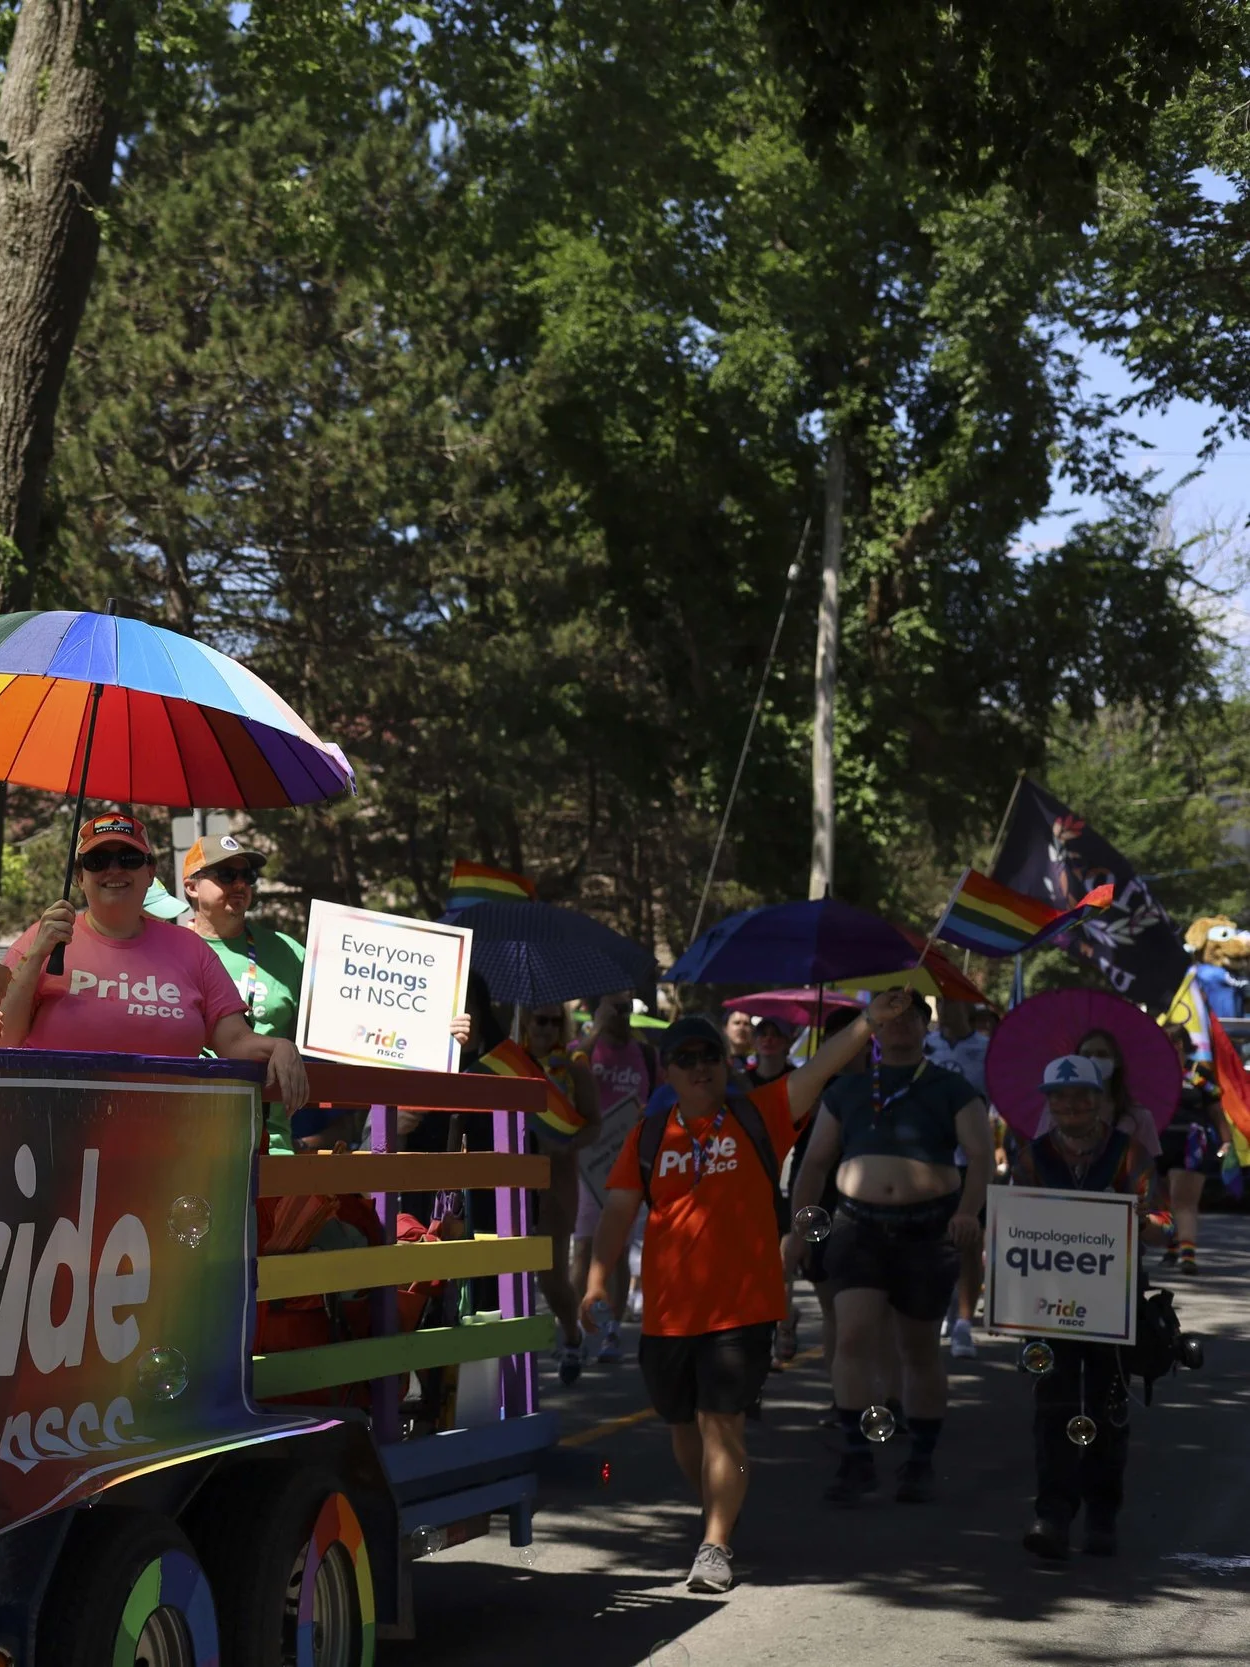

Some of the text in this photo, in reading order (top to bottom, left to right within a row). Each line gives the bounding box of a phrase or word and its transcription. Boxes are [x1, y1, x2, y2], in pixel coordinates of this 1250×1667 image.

[342, 934, 435, 967] Everyone
[344, 957, 427, 991] belongs
[69, 969, 181, 1003] Pride
[340, 985, 427, 1013] at NSCC
[127, 1003, 184, 1019] nscc
[352, 1025, 407, 1050] Pride
[376, 1048, 405, 1059] nscc
[592, 1063, 642, 1085] Pride
[704, 1159, 738, 1177] scc
[1008, 1227, 1115, 1248] Unapologetically
[1006, 1246, 1115, 1277] queer
[1036, 1297, 1087, 1318] Pride
[1058, 1317, 1086, 1327] nscc
[0, 1396, 155, 1474] nscc
